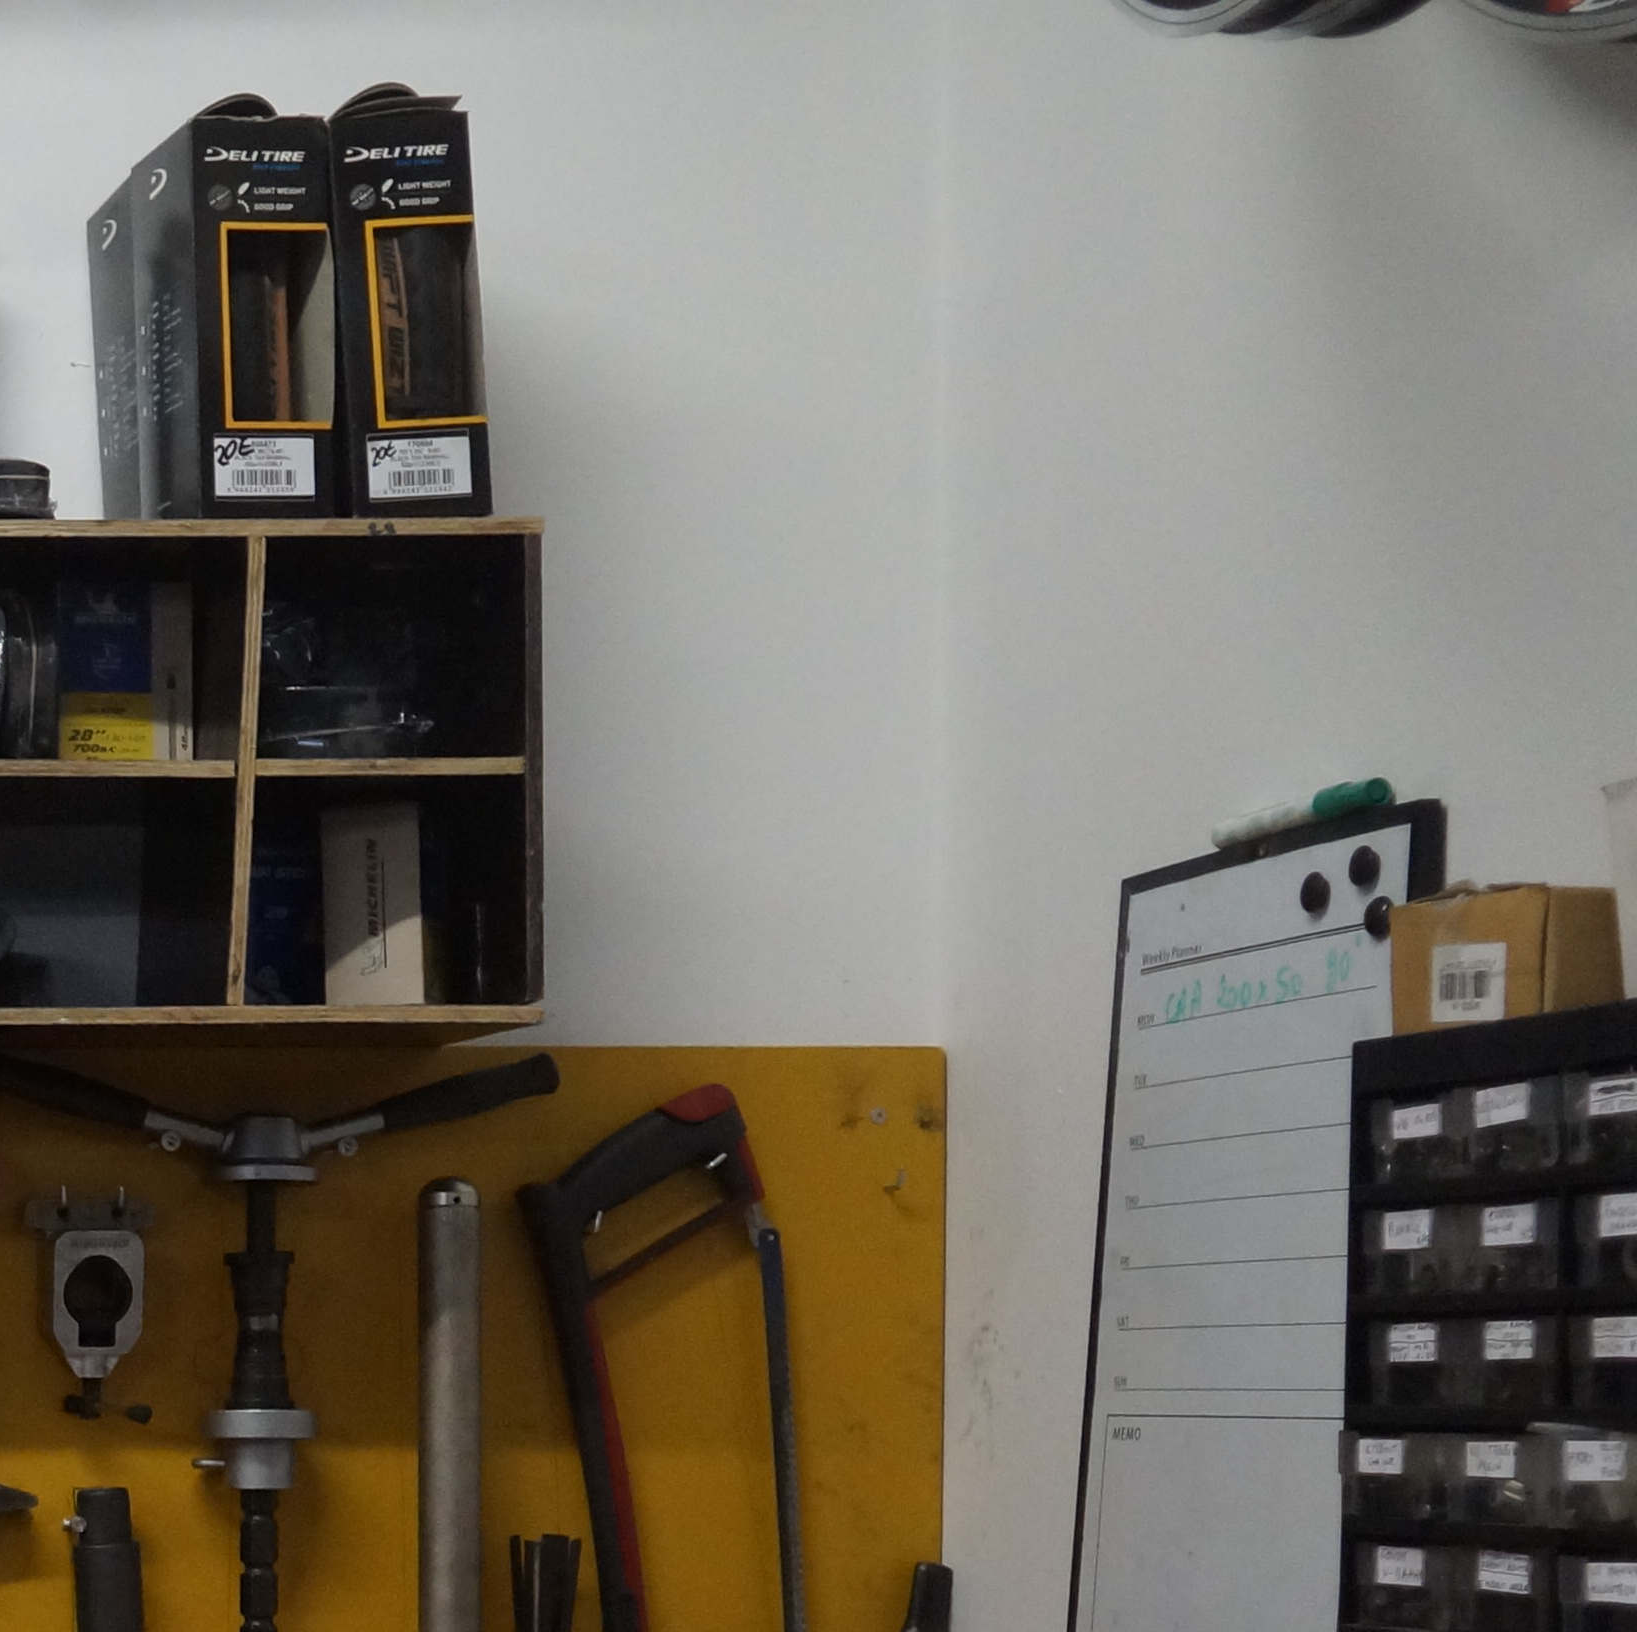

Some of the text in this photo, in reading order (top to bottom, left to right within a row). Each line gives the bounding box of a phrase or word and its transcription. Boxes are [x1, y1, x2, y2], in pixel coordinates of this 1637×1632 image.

[261, 150, 305, 162] TIRE
[404, 144, 449, 157] TIRE
[1112, 1427, 1141, 1440] MEMO
